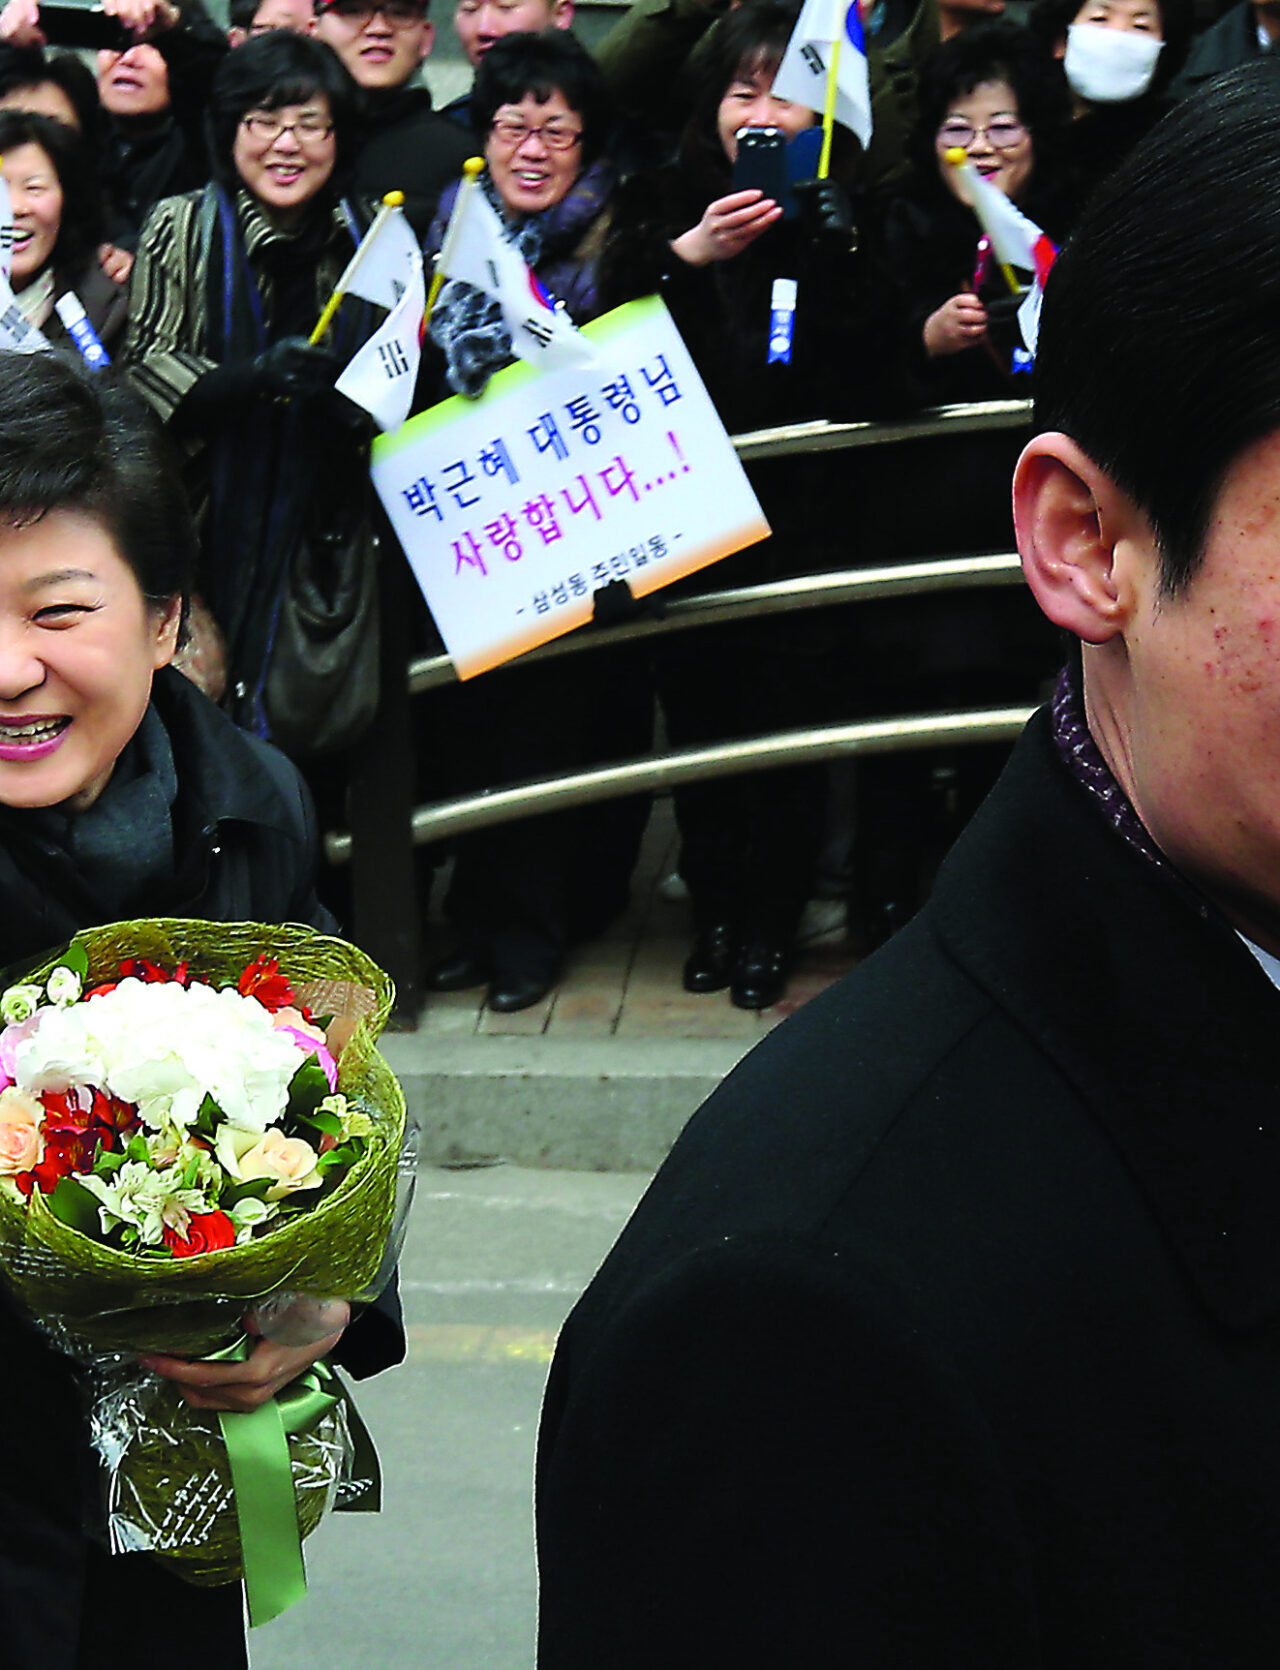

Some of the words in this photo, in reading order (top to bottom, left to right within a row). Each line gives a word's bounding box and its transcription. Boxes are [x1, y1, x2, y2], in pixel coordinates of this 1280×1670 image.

[401, 438, 520, 521] 박근혜
[526, 354, 682, 461] 대통령님
[533, 573, 588, 614] 삼성동
